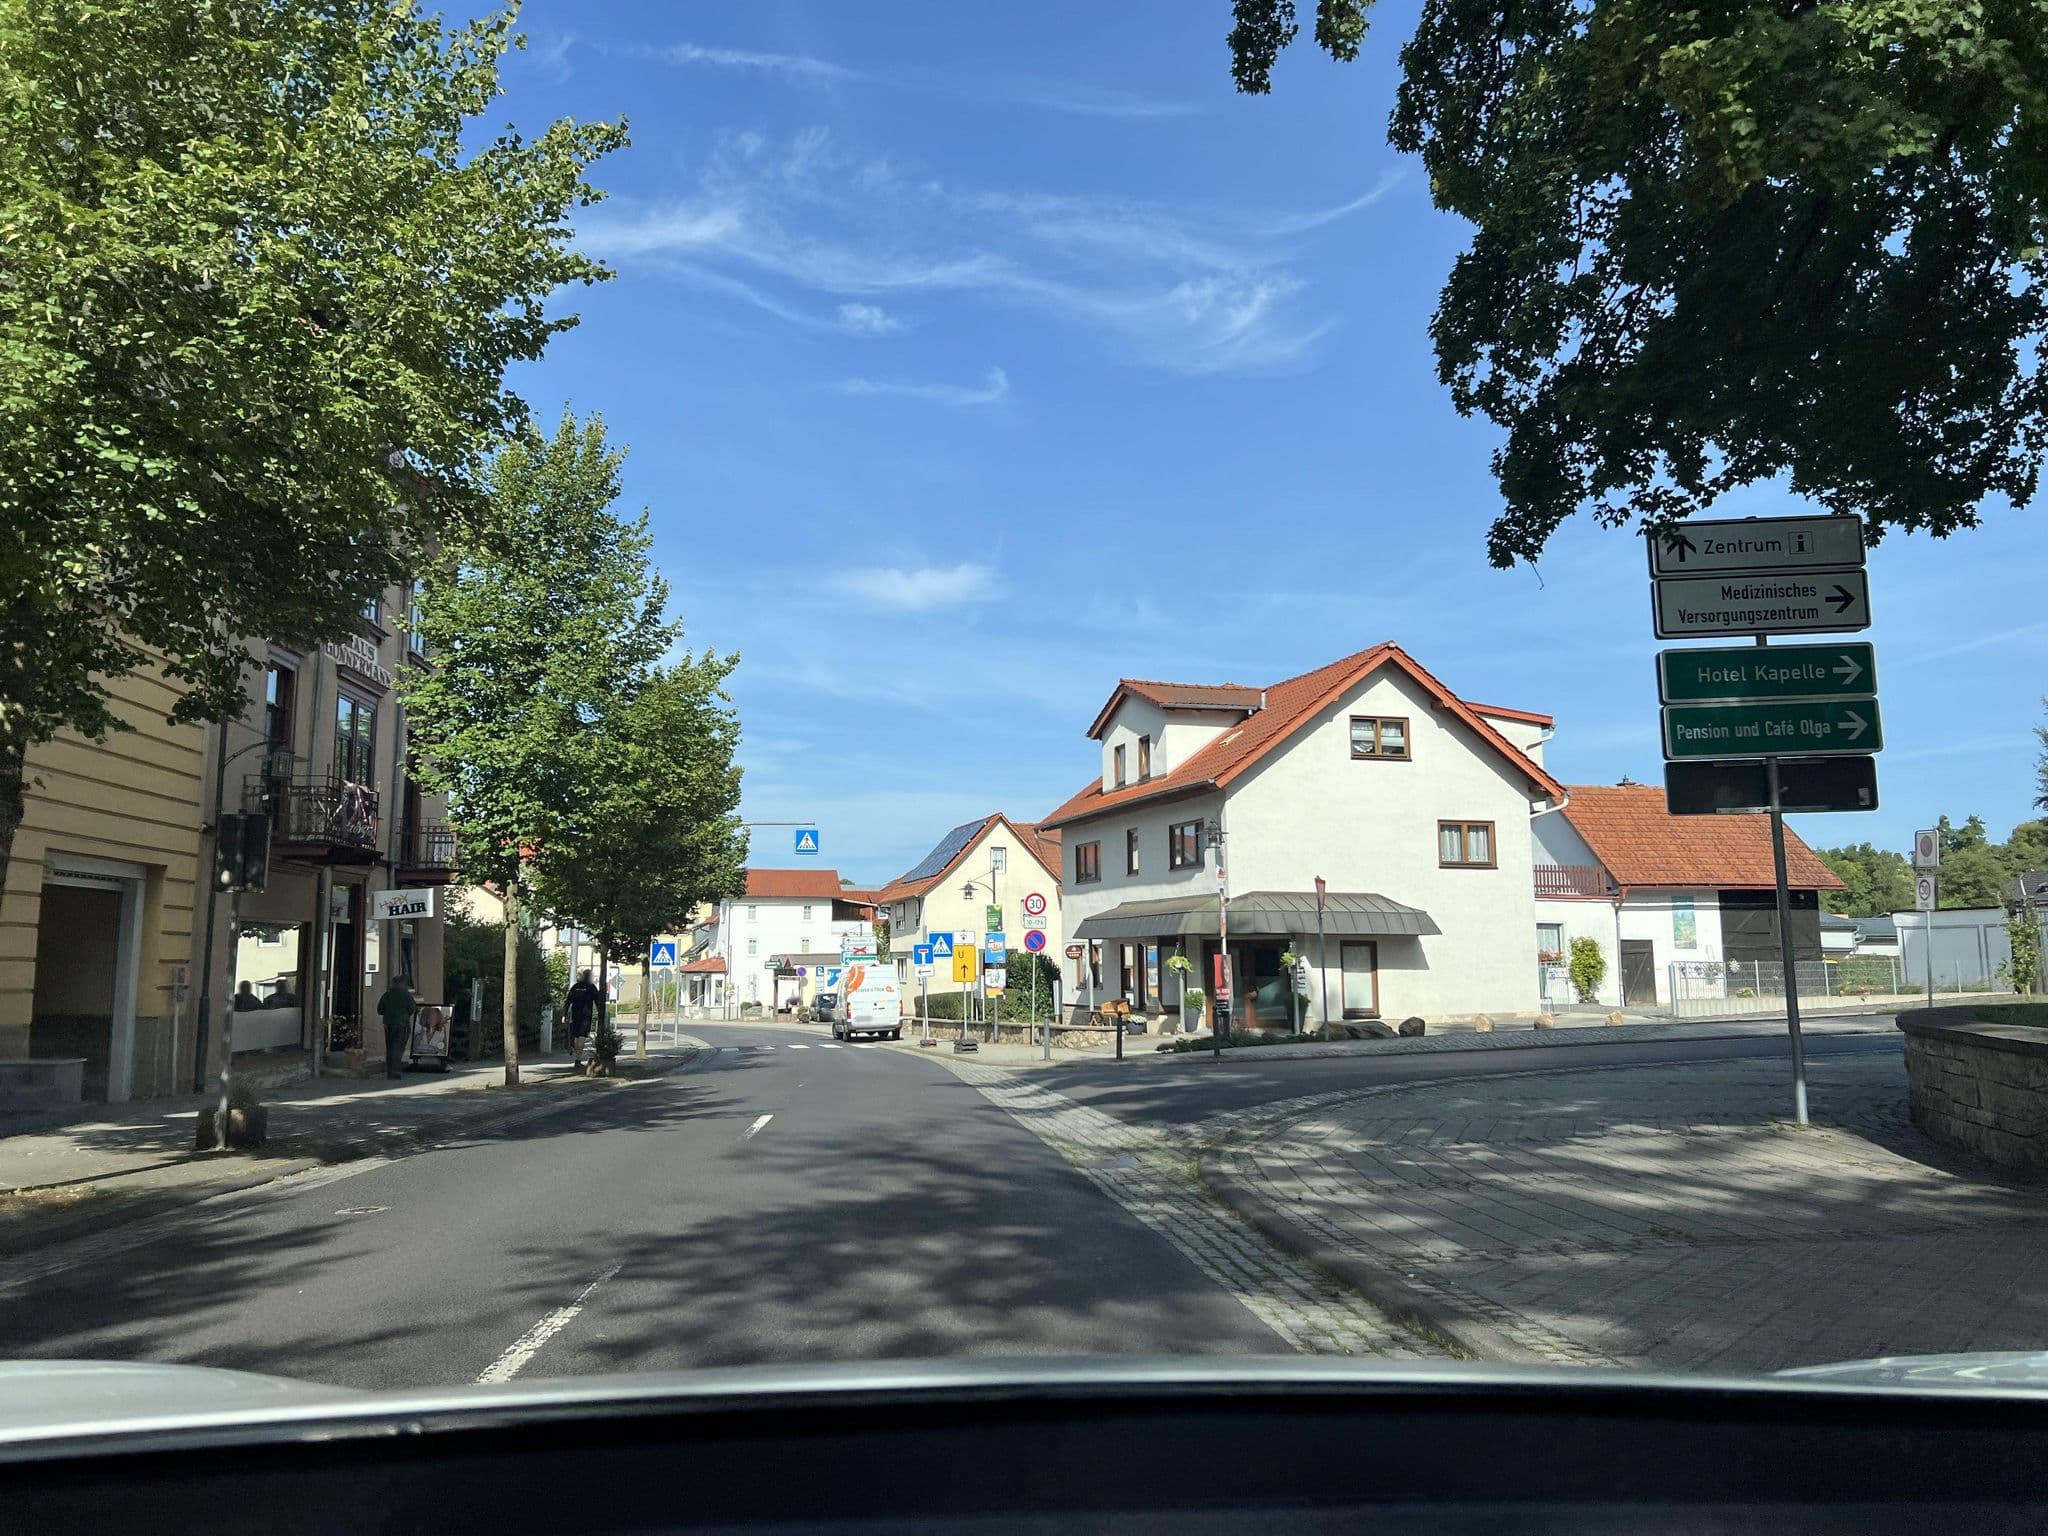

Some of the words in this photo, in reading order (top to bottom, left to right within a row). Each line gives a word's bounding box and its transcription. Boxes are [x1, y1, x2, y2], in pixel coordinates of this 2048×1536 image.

[1704, 539, 1782, 555] Zentrum
[1721, 583, 1817, 601] Medizinisches
[1678, 606, 1819, 626] Versorgungszentrum
[1698, 666, 1747, 683] Hotel
[1755, 664, 1825, 684] Kapelle
[1676, 722, 1729, 740] Pension
[1735, 721, 1760, 737] und
[1765, 719, 1795, 737] Café
[1800, 719, 1831, 738] Olga
[389, 902, 427, 916] HAIR
[1029, 899, 1042, 910] 30
[958, 951, 965, 959] U
